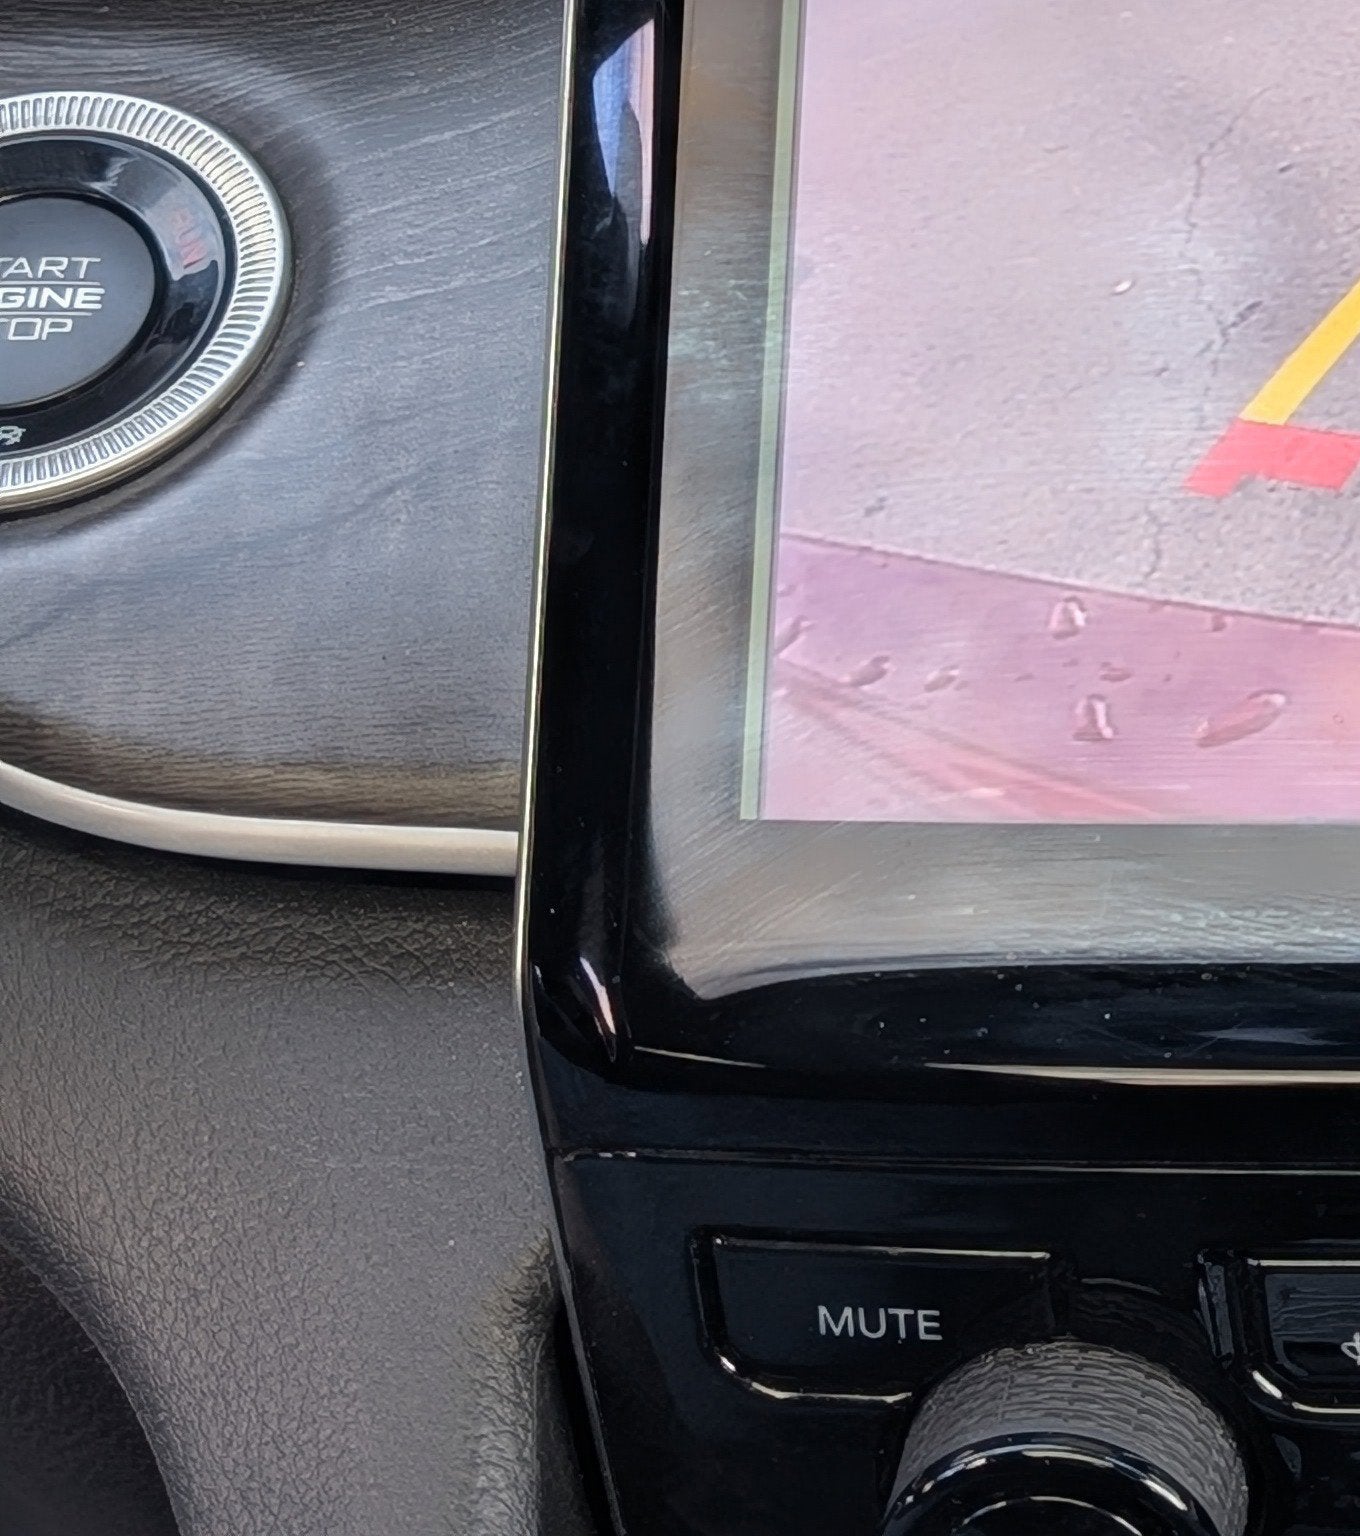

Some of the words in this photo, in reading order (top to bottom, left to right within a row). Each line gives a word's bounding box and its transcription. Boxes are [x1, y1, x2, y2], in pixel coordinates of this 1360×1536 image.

[0, 256, 102, 279] ART
[0, 287, 106, 310] GINE
[0, 317, 74, 341] OP
[817, 1305, 943, 1341] MUTE
